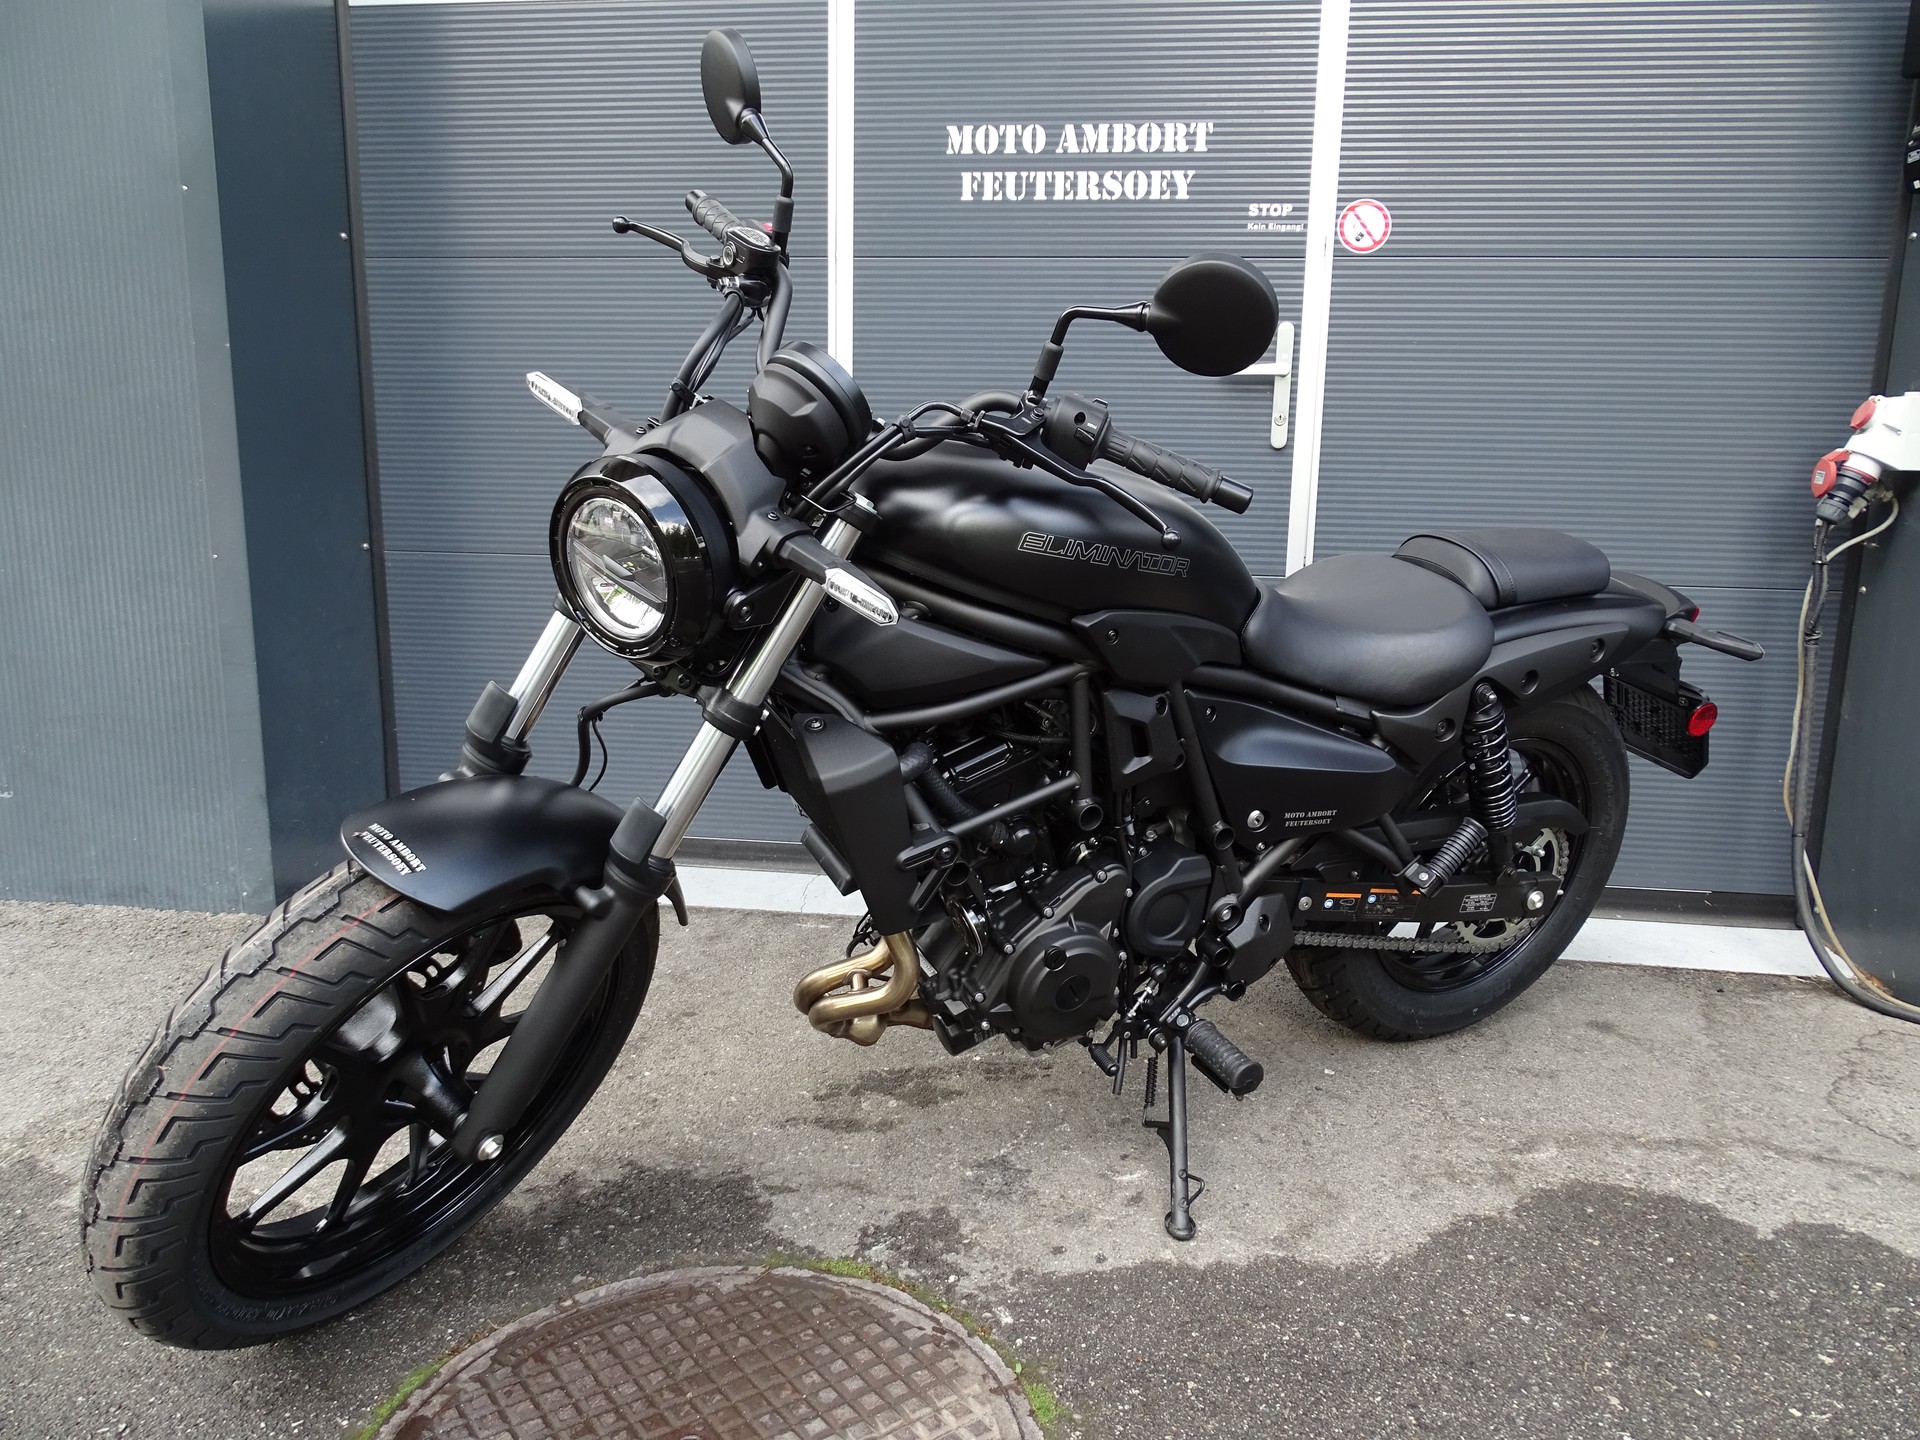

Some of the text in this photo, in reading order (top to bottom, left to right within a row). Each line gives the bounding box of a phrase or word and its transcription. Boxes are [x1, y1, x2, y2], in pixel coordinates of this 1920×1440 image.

[946, 122, 1214, 155] MOTO AMBORT
[961, 170, 1196, 201] FEUTERSOEY
[1248, 203, 1293, 217] STOP
[1017, 531, 1190, 577] ELIMINATOR
[1285, 818, 1332, 827] FEUTERSOEY
[1306, 809, 1338, 818] AMBORT
[360, 831, 412, 876] FEUTERSOEY
[368, 822, 427, 872] MOTO AMBORT
